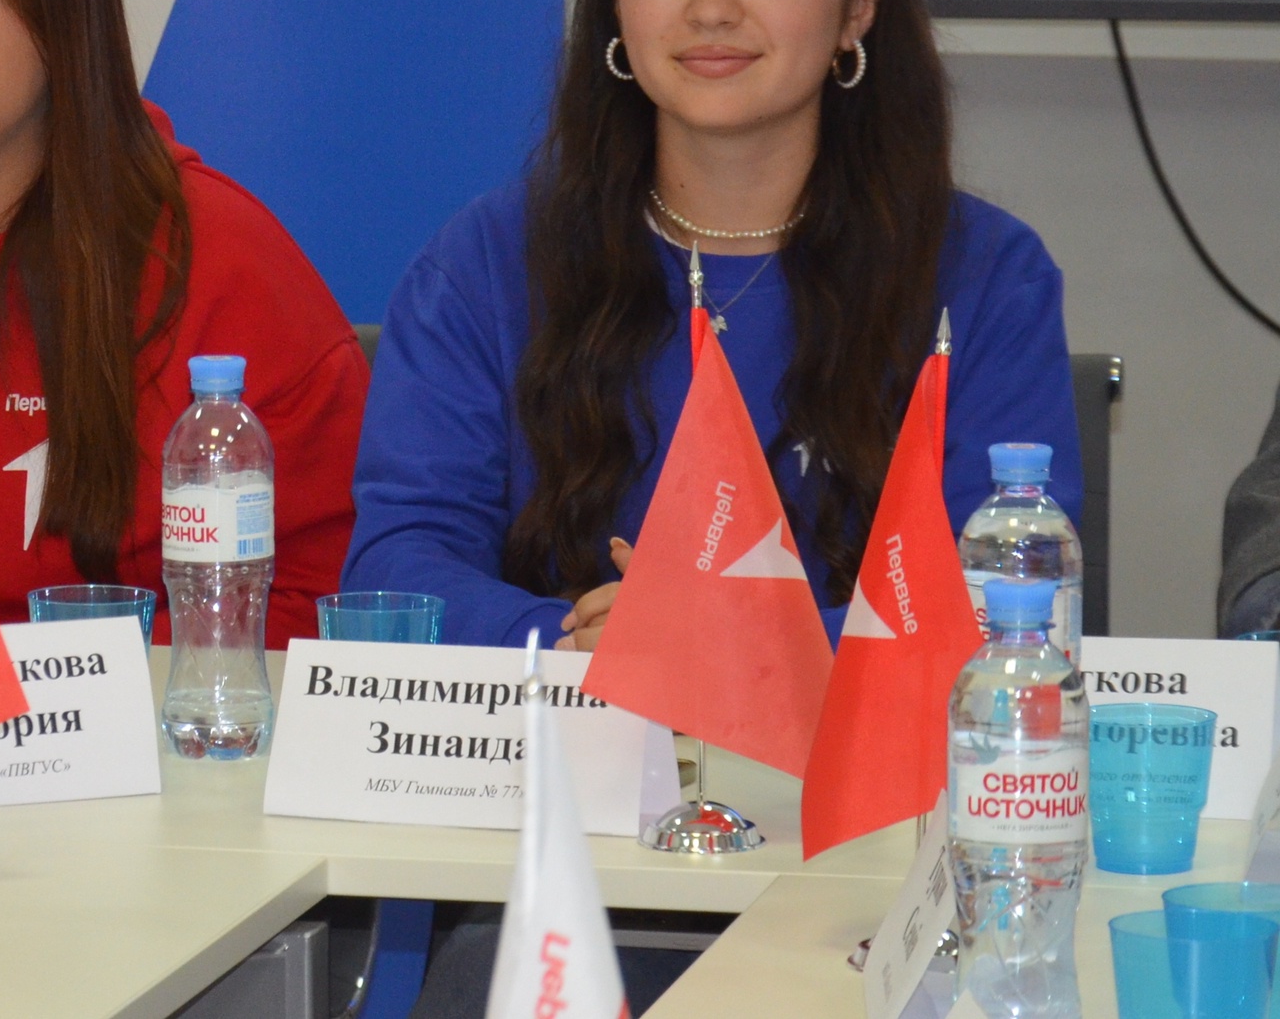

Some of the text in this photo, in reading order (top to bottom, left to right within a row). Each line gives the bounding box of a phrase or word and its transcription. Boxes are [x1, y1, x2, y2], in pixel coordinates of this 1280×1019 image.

[5, 393, 46, 417] Пер
[161, 503, 205, 523] ВЯТОЙ
[886, 534, 918, 635] Первые
[0, 758, 71, 778] «ПВГУС»
[983, 766, 1079, 794] СВЯТОЙ
[364, 778, 402, 793] МБУ
[405, 780, 476, 797] Гимназия
[479, 784, 498, 798] №
[967, 794, 1086, 820] ИСТОЧНИК
